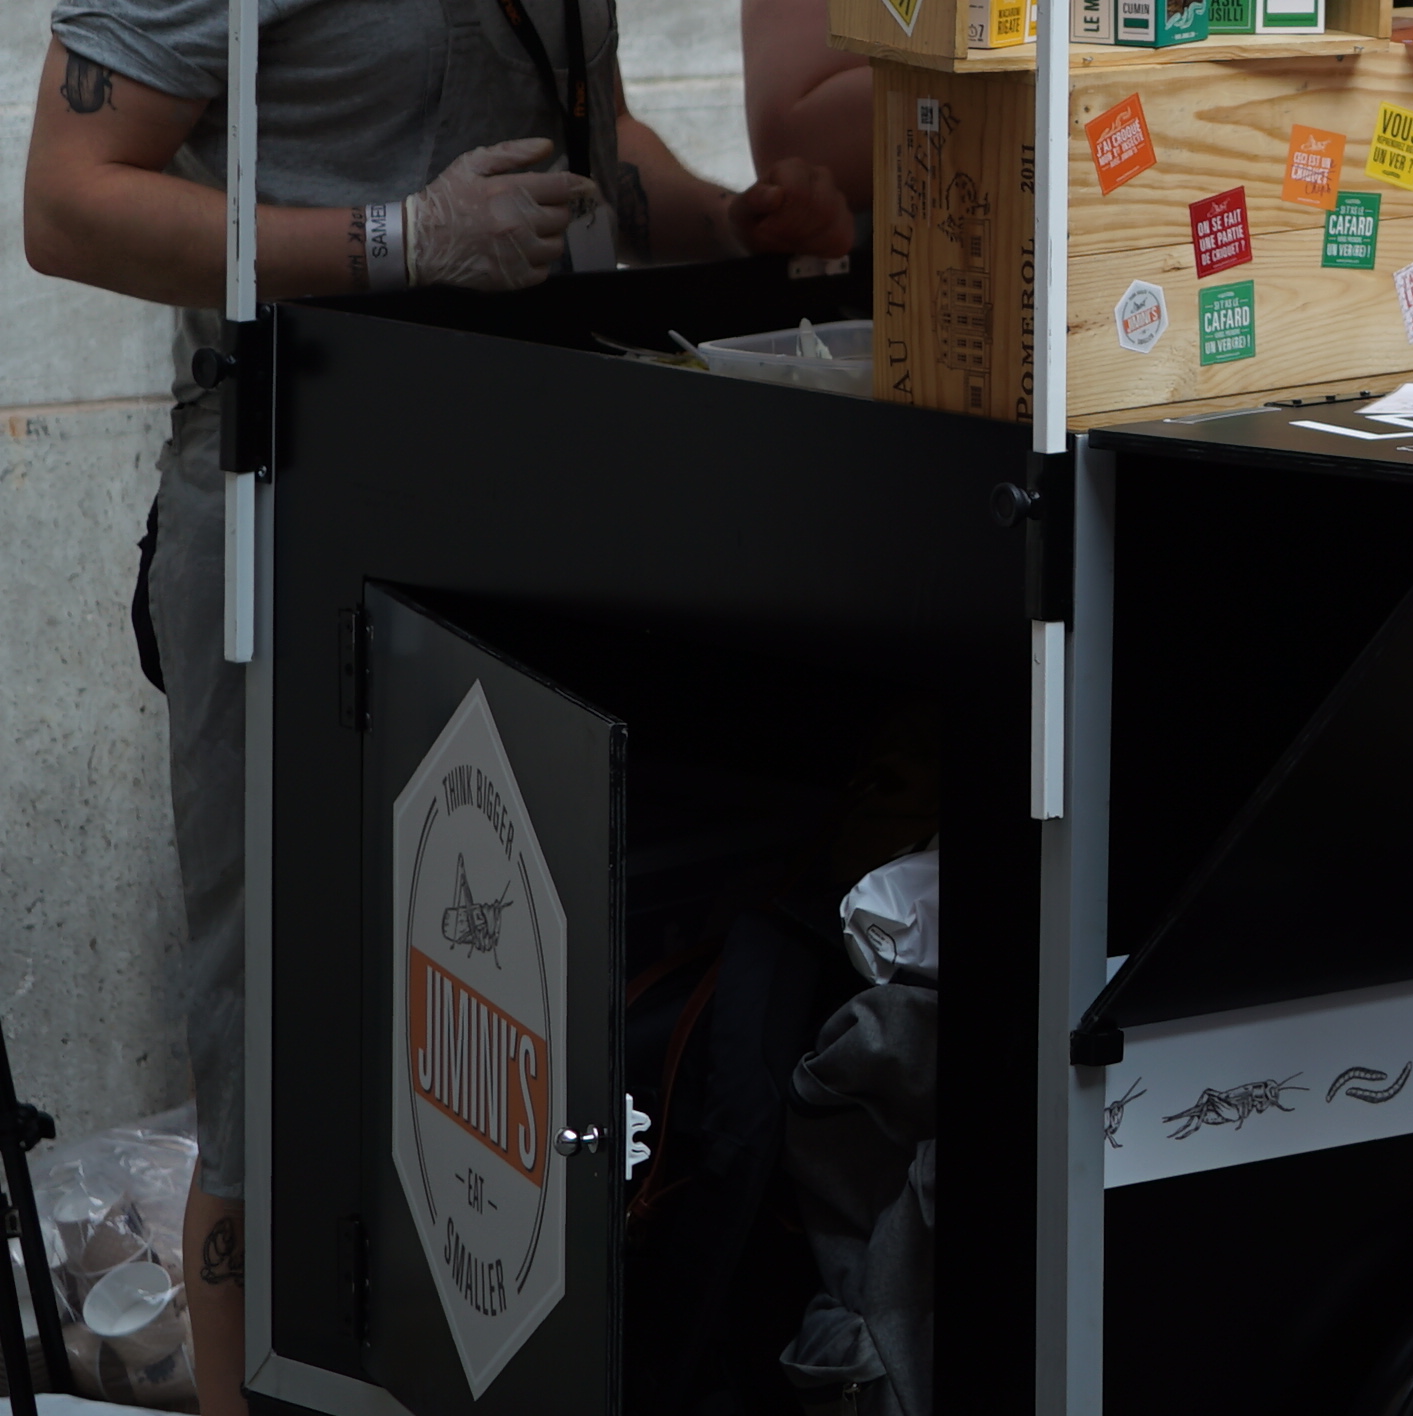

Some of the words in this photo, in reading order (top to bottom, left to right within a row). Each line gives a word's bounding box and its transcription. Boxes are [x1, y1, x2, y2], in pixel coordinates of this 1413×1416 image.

[1122, 3, 1150, 15] CUMIN
[1208, 8, 1243, 22] USILLI
[1084, 16, 1099, 32] LE
[1021, 144, 1035, 194] 2011
[1373, 146, 1387, 165] UN
[1389, 151, 1406, 171] VER
[1197, 220, 1210, 236] ON
[1211, 216, 1222, 232] SE
[1223, 208, 1241, 227] FAIT
[1328, 215, 1374, 237] CAFARD
[1199, 235, 1216, 252] UNE
[1217, 225, 1244, 246] PARTIE
[1016, 239, 1035, 422] POMEROL
[1204, 306, 1250, 333] CAFARD
[442, 764, 475, 816] THINK
[476, 766, 515, 861] BIGGER
[418, 965, 538, 1174] JIMINI'S
[468, 1168, 485, 1215] EAT
[444, 1216, 507, 1317] SMALLER
